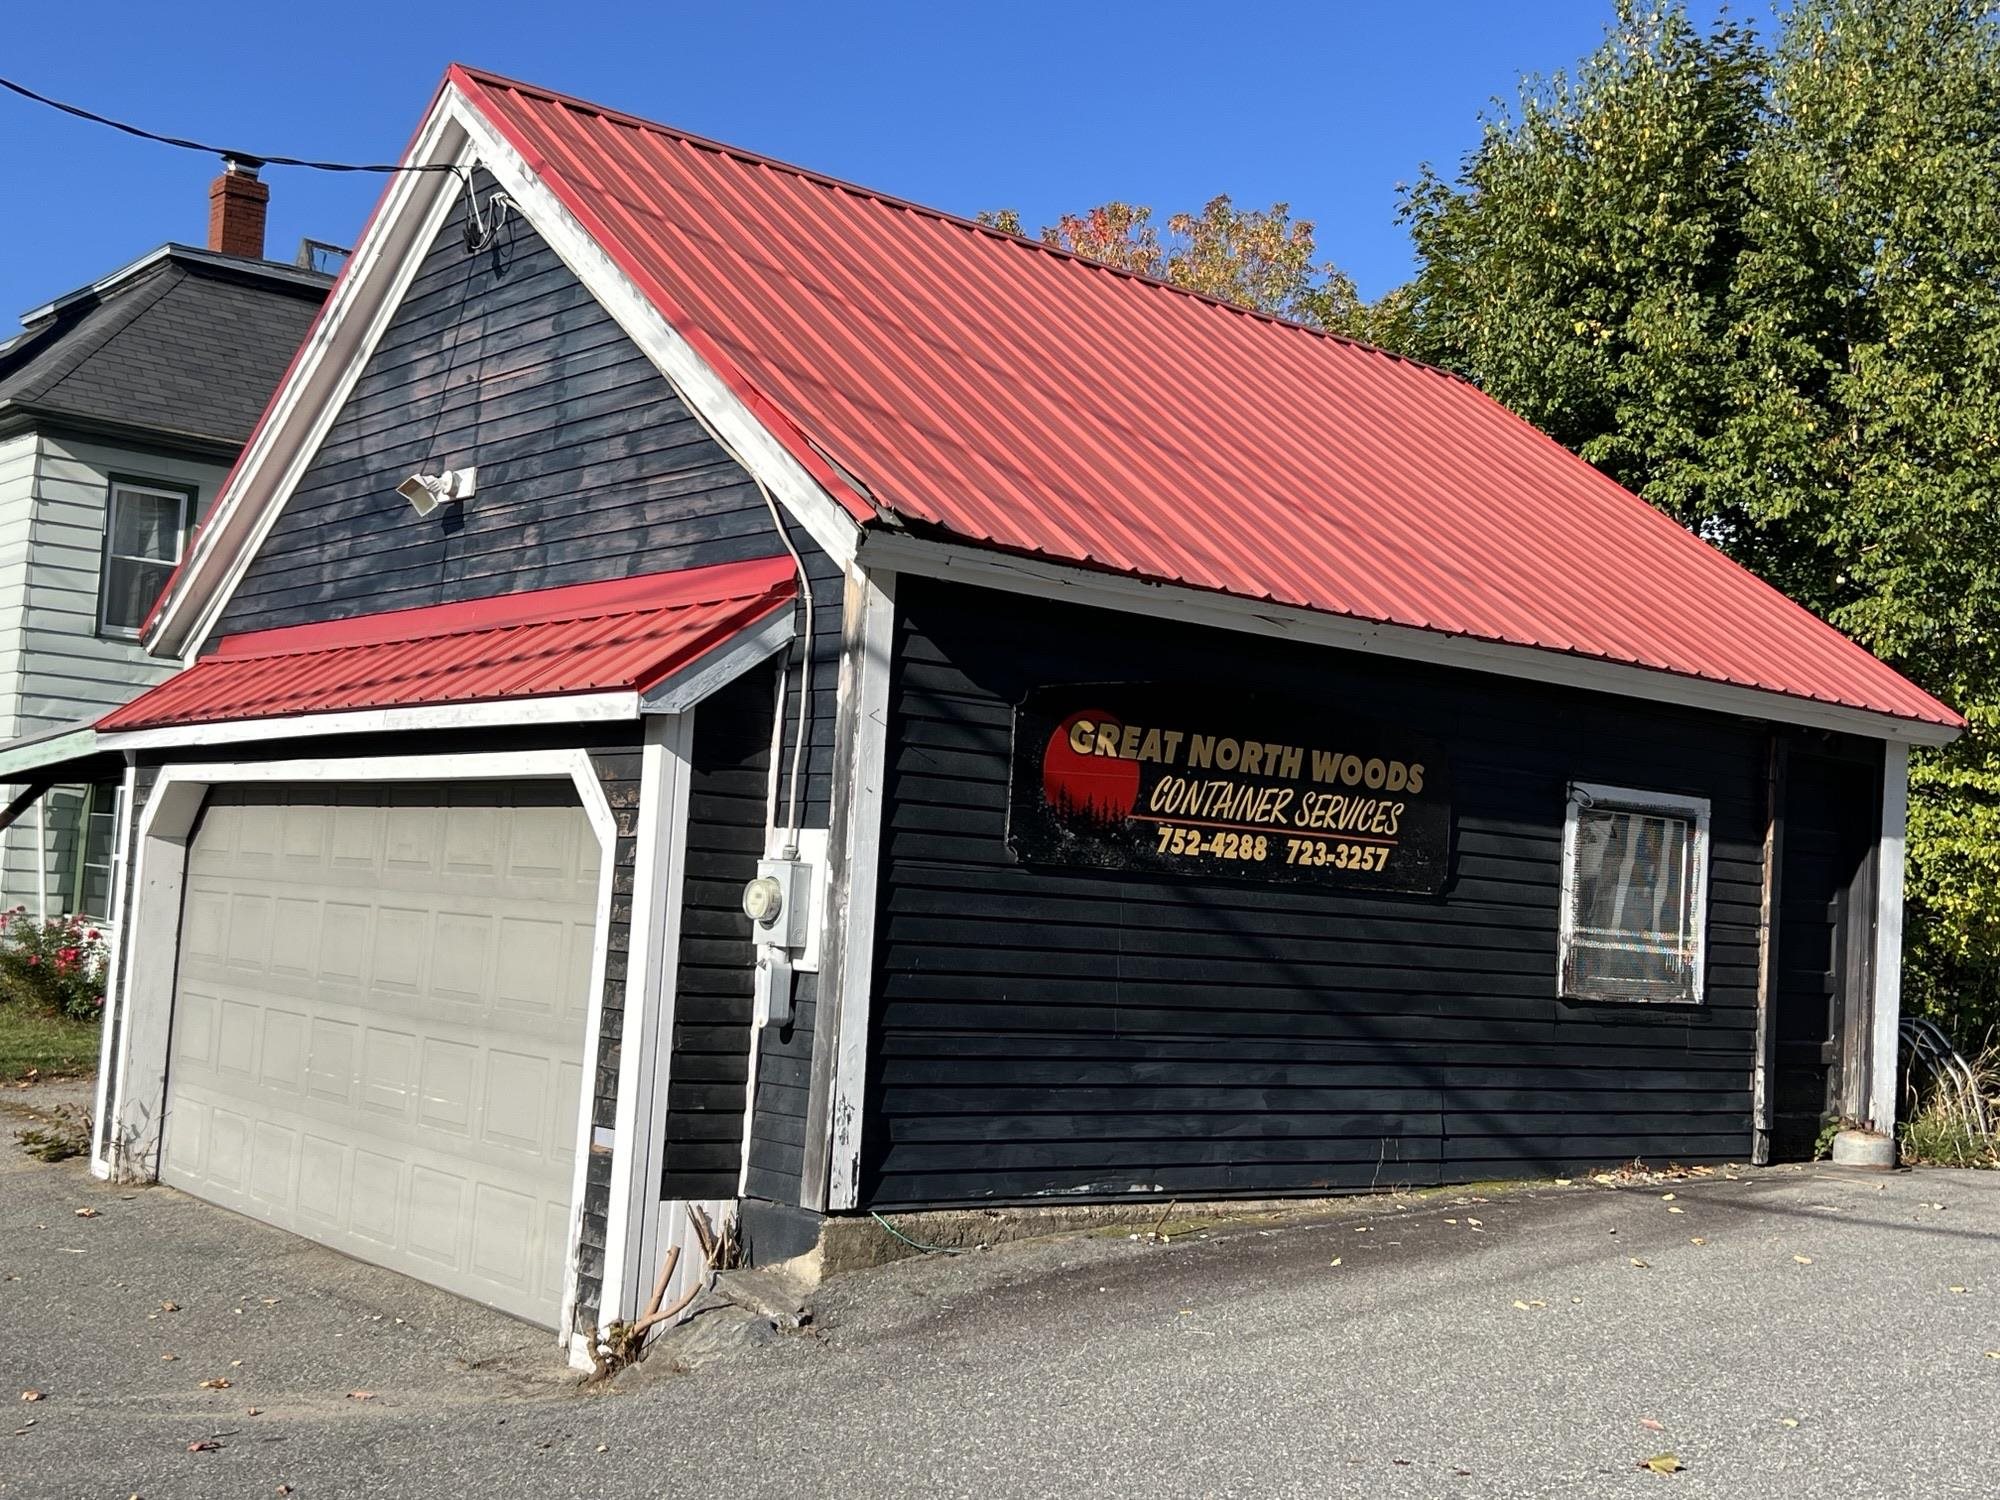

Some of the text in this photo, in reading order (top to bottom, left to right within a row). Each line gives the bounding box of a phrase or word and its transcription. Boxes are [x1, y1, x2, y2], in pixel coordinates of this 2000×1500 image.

[1069, 720, 1425, 794] GREAT NORTH WOODS
[1150, 775, 1405, 835] CONTAINER SERVICES
[1157, 827, 1390, 872] 752-4288 723-3257
